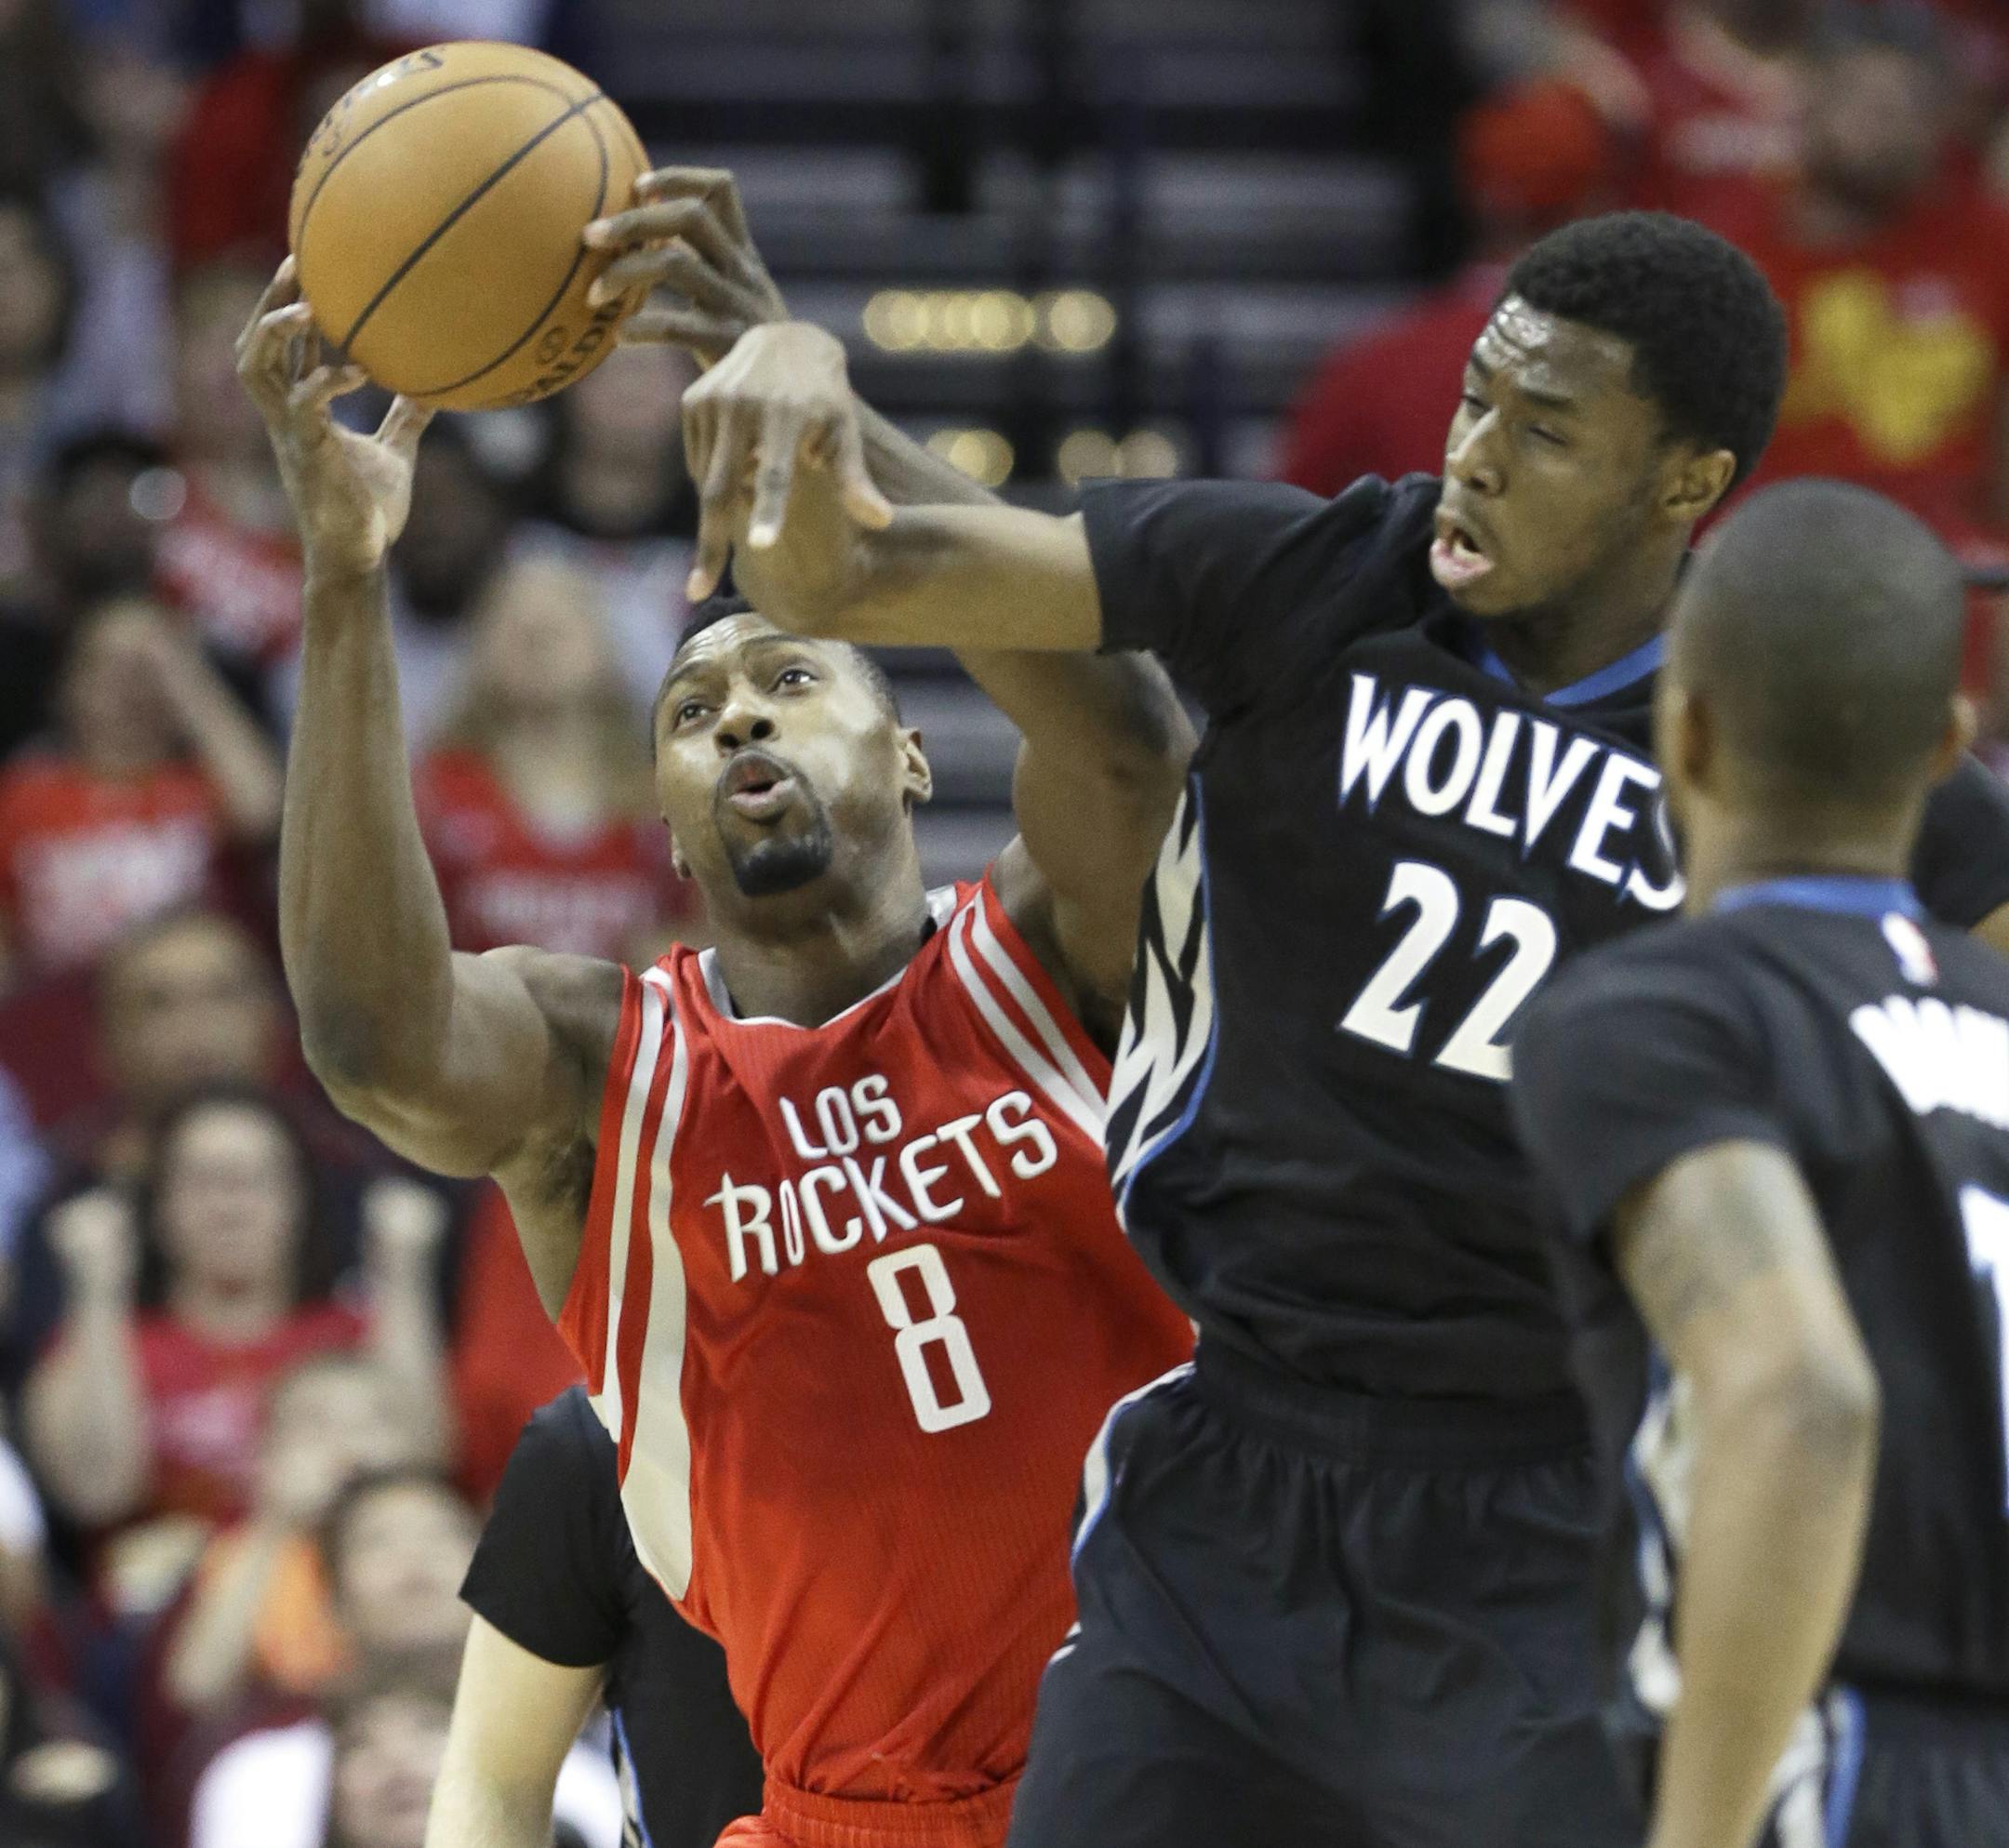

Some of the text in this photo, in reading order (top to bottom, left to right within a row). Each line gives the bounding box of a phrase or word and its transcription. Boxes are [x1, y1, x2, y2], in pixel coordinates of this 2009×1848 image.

[1336, 858, 1558, 1082] 22
[703, 1090, 1058, 1283] ROCKETS
[779, 1073, 902, 1160] LOS
[866, 1243, 992, 1434] 8
